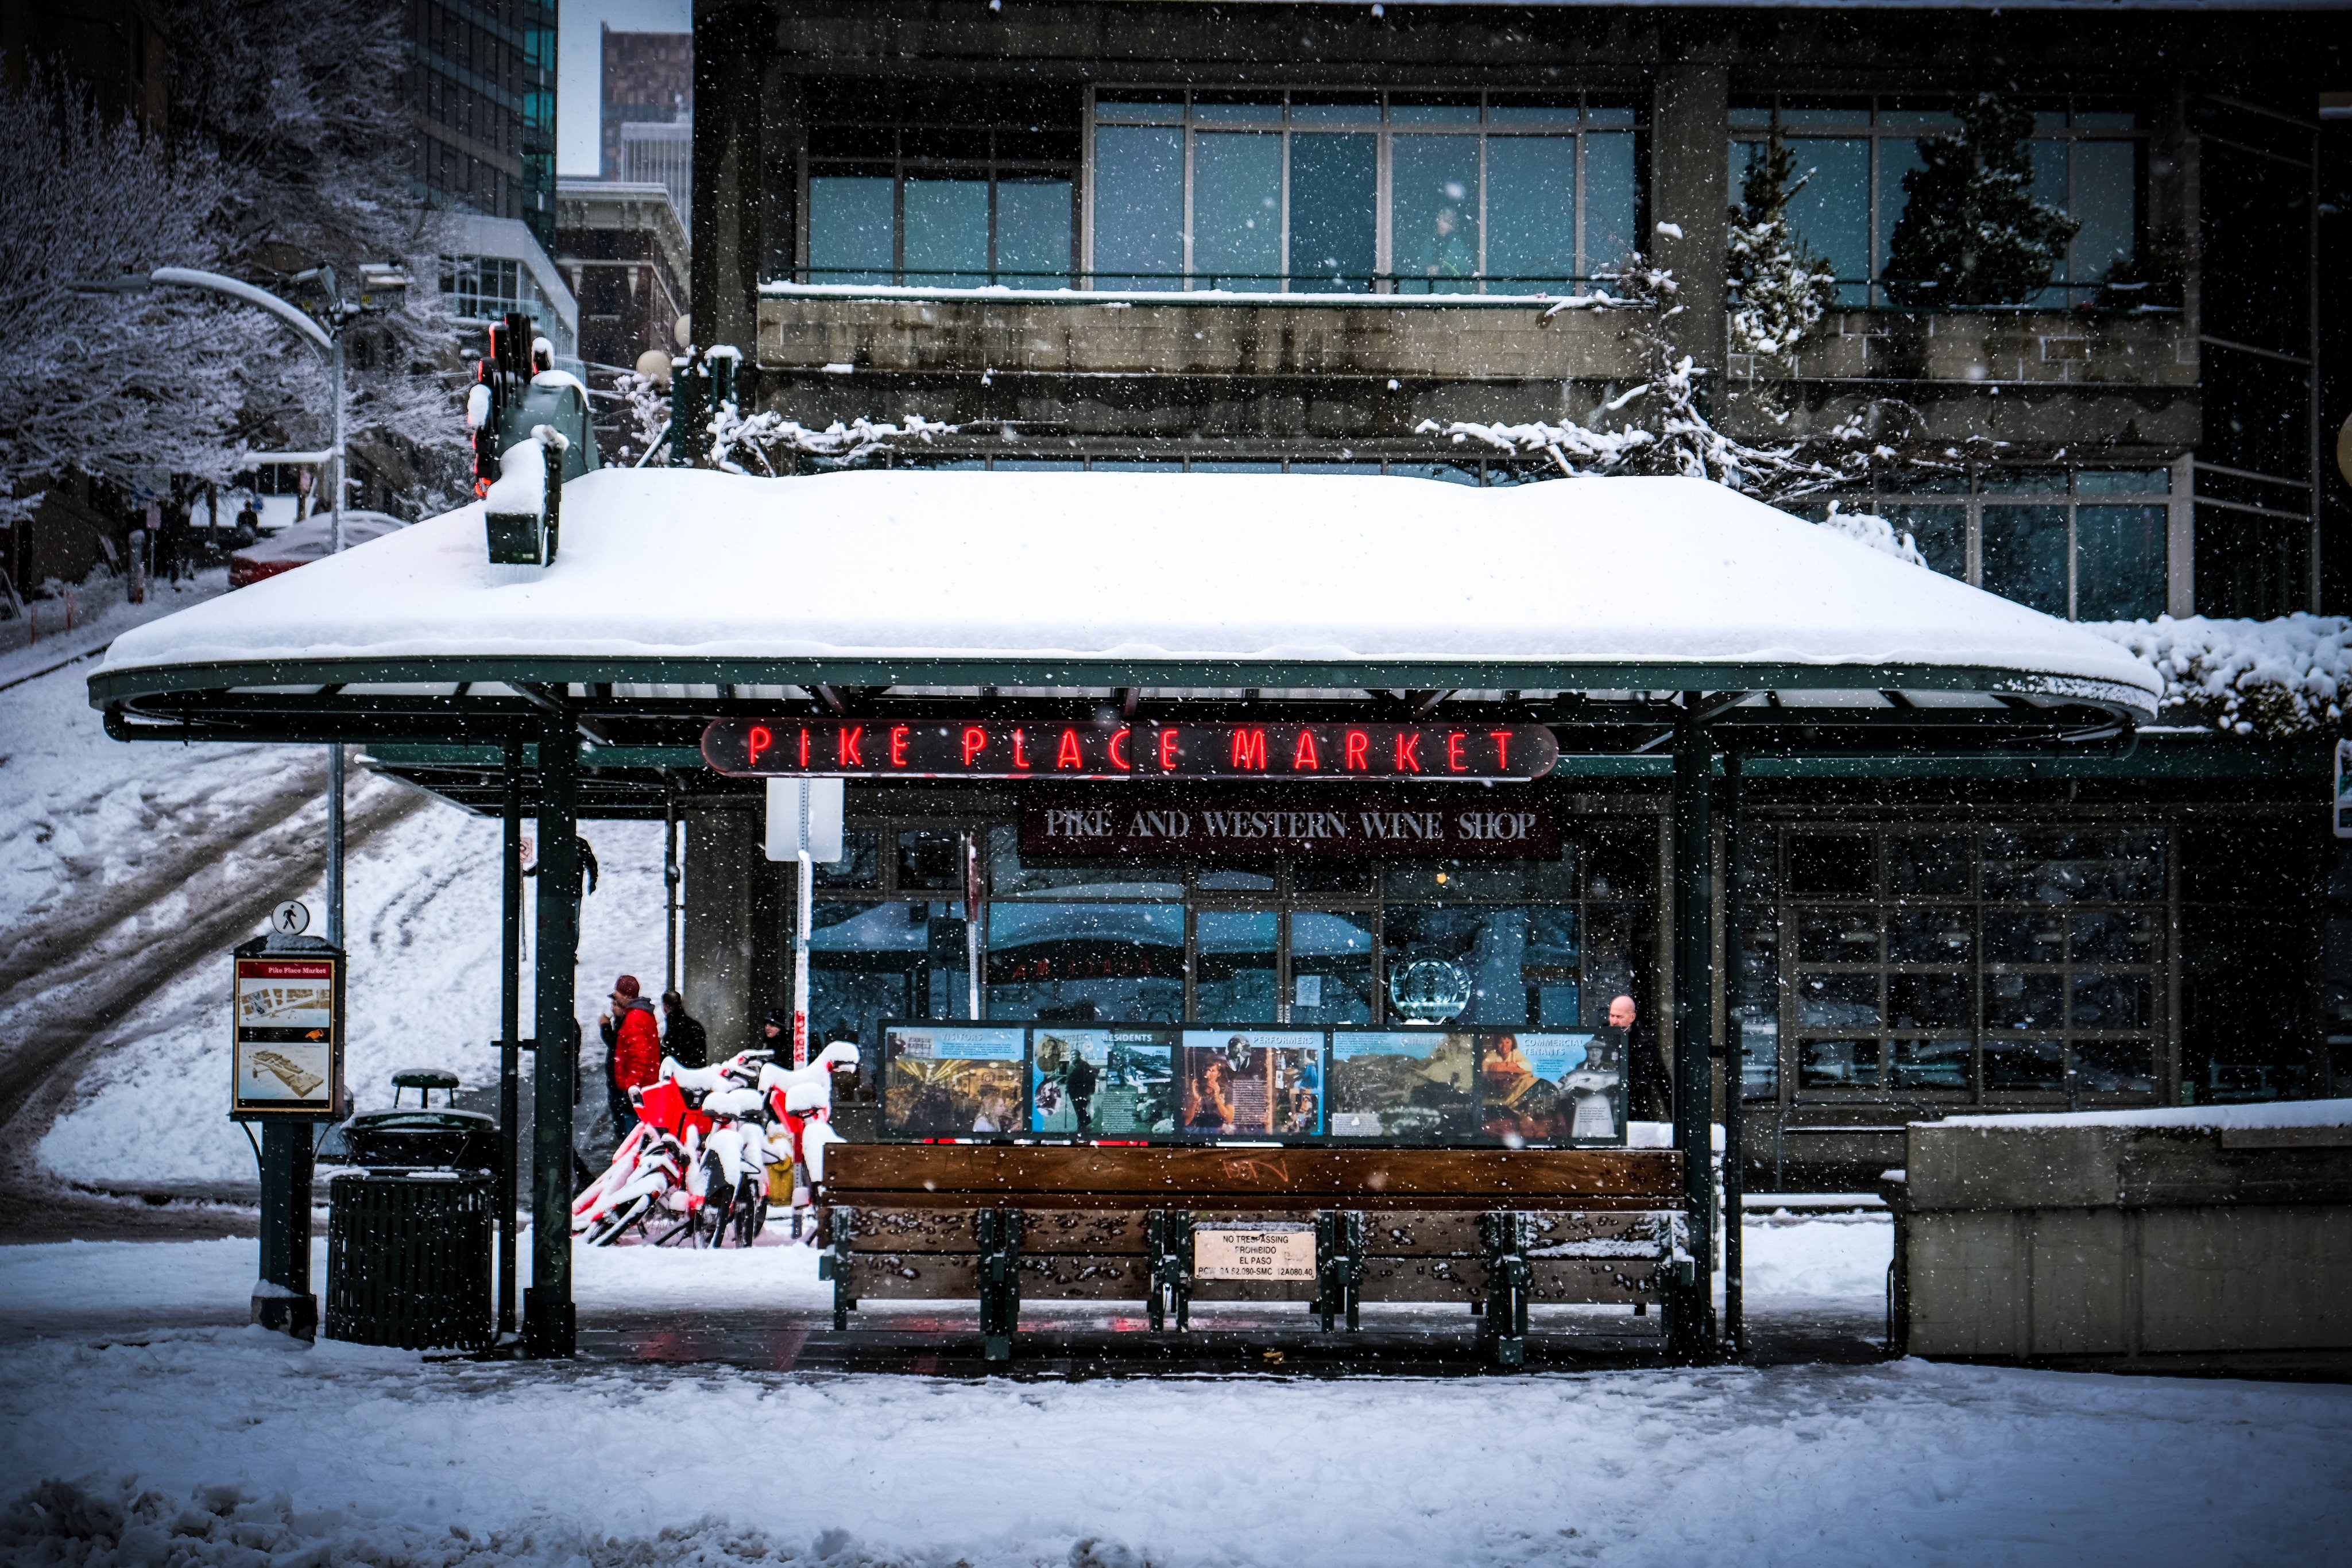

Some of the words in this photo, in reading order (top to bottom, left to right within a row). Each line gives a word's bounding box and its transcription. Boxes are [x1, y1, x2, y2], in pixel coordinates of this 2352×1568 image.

[748, 726, 910, 767] PIKE
[965, 727, 1177, 769] PLACE
[1232, 729, 1512, 772] MARKET
[1045, 810, 1112, 837] PIKE
[1127, 810, 1190, 837] AND
[1202, 811, 1347, 838] WESTERN
[1359, 812, 1443, 839] WINE
[1459, 812, 1537, 839] SHOP
[941, 1033, 983, 1042] VISITORS
[1102, 1033, 1152, 1042] RESIDENTS
[1253, 1036, 1314, 1045] PERFORMERS
[1525, 1048, 1566, 1056] TENANTS
[1236, 1236, 1289, 1244] TRESPASSING
[1251, 1257, 1271, 1265] PASO
